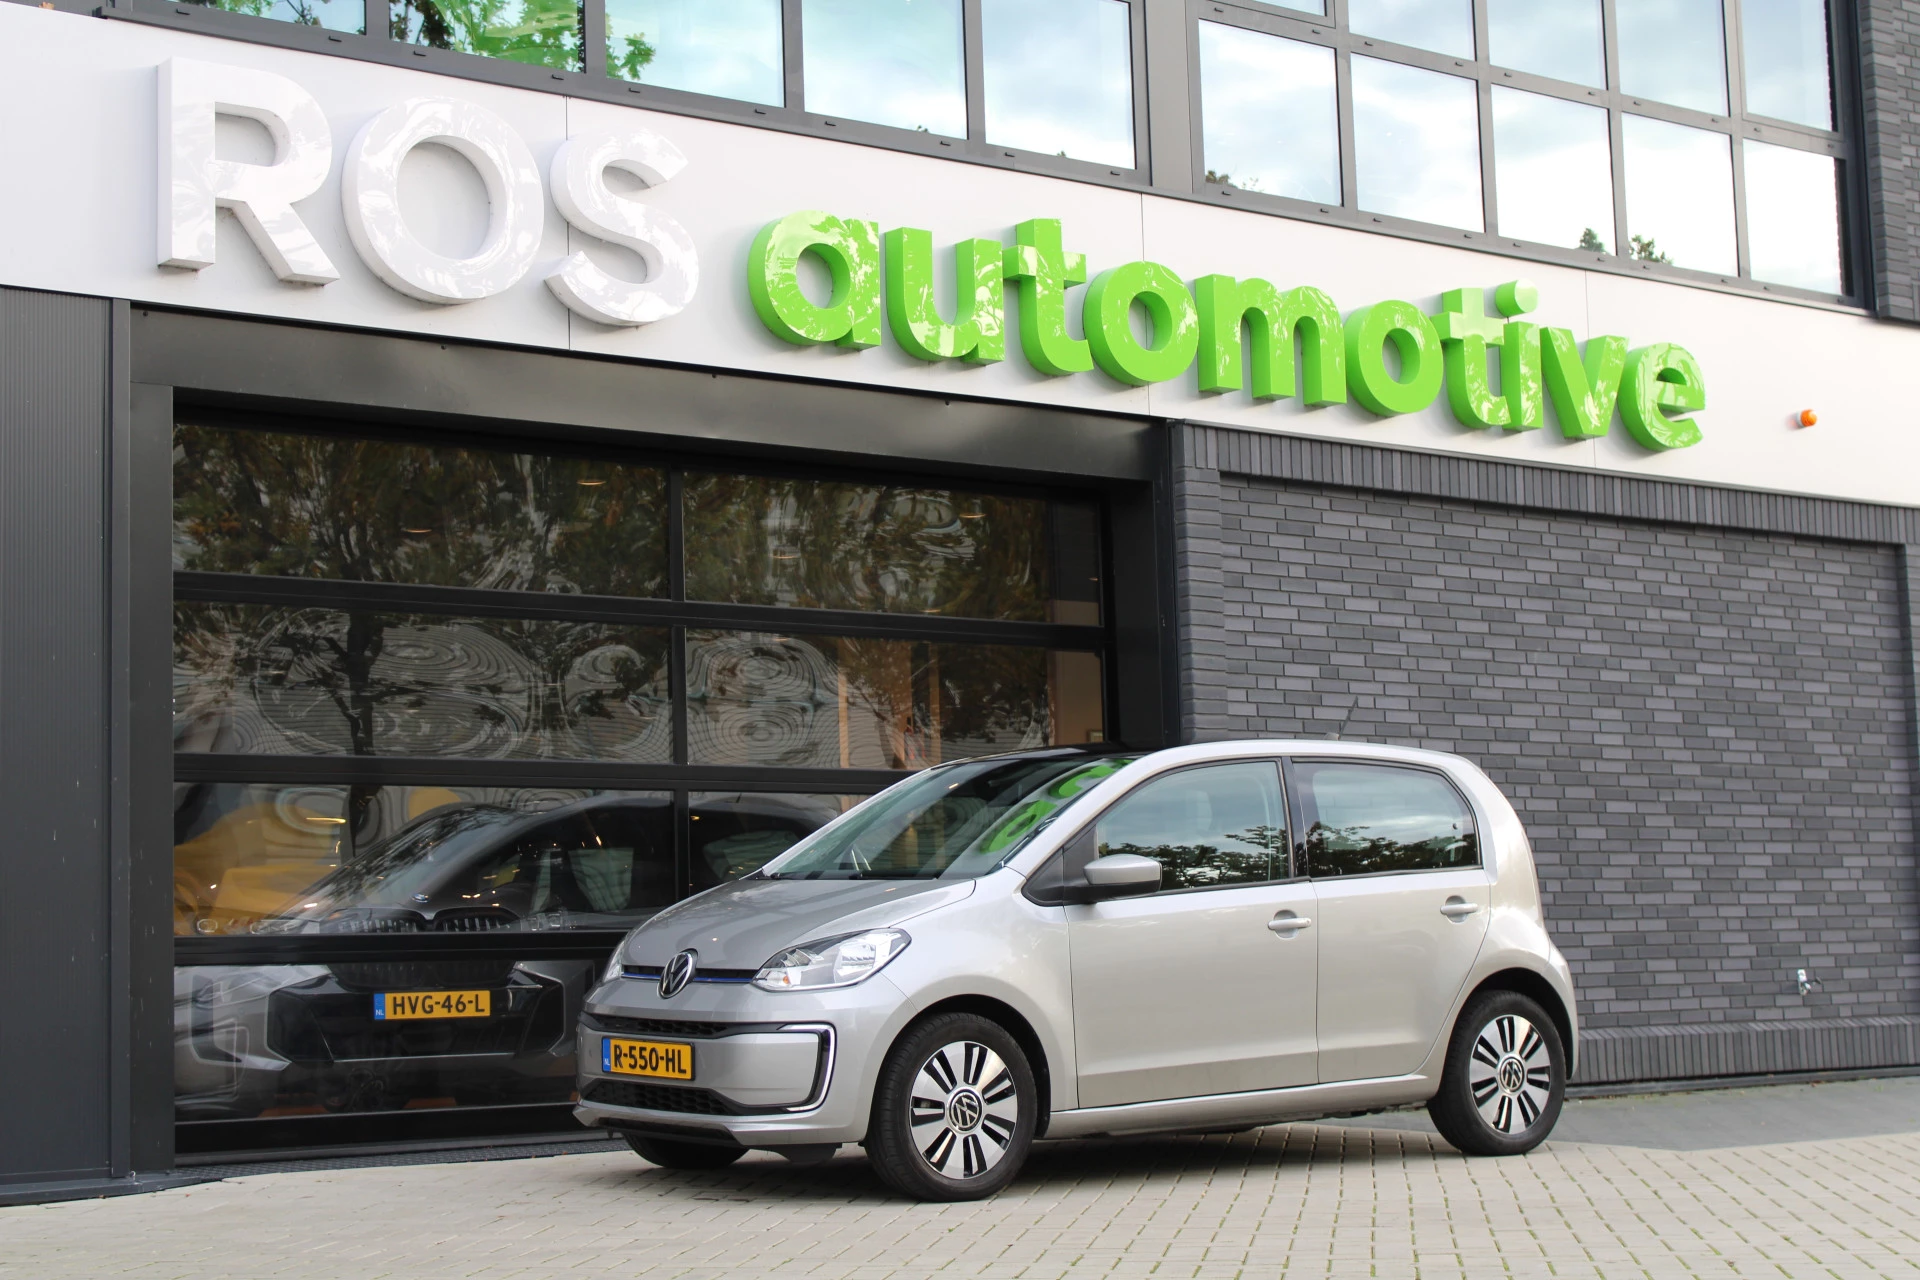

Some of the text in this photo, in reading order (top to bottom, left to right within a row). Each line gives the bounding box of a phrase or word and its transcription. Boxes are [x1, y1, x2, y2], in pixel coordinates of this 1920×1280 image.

[157, 57, 1706, 453] ROS automotive
[392, 994, 486, 1016] HVG-46-L
[613, 1044, 687, 1074] R-550-HL
